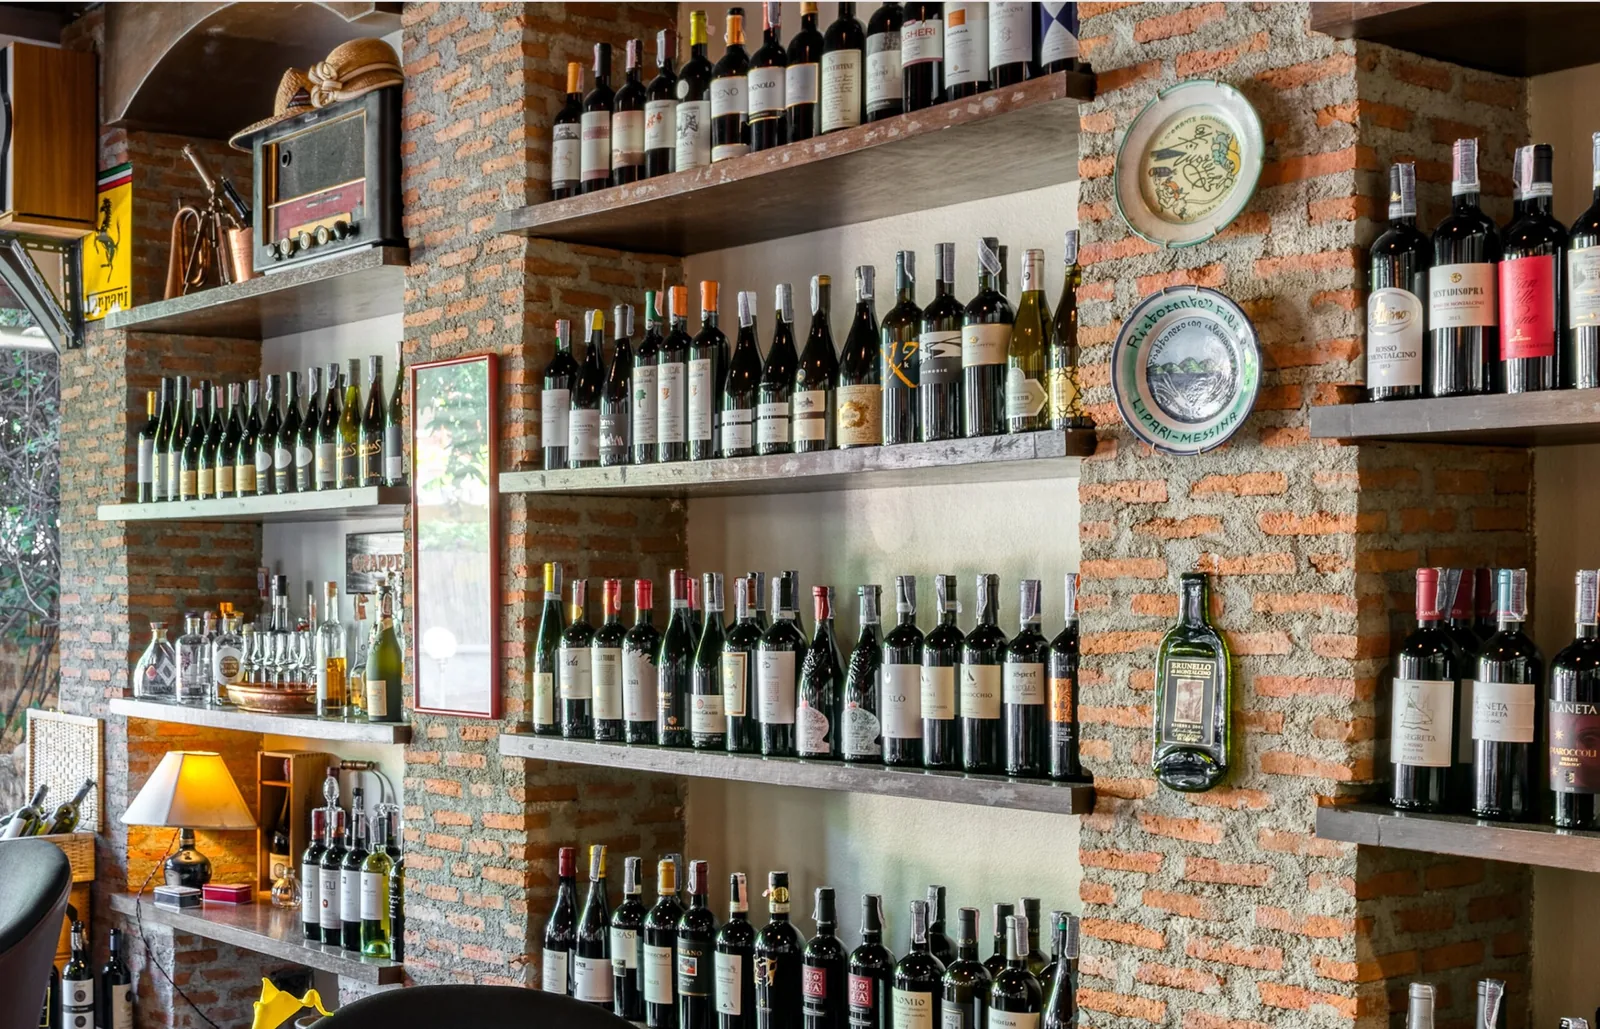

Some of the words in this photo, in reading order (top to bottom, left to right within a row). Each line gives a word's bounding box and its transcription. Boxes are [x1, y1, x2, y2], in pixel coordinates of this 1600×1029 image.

[1375, 344, 1397, 354] ROSSO
[1171, 662, 1212, 671] BRUNELLO
[1551, 701, 1598, 715] PLANETA
